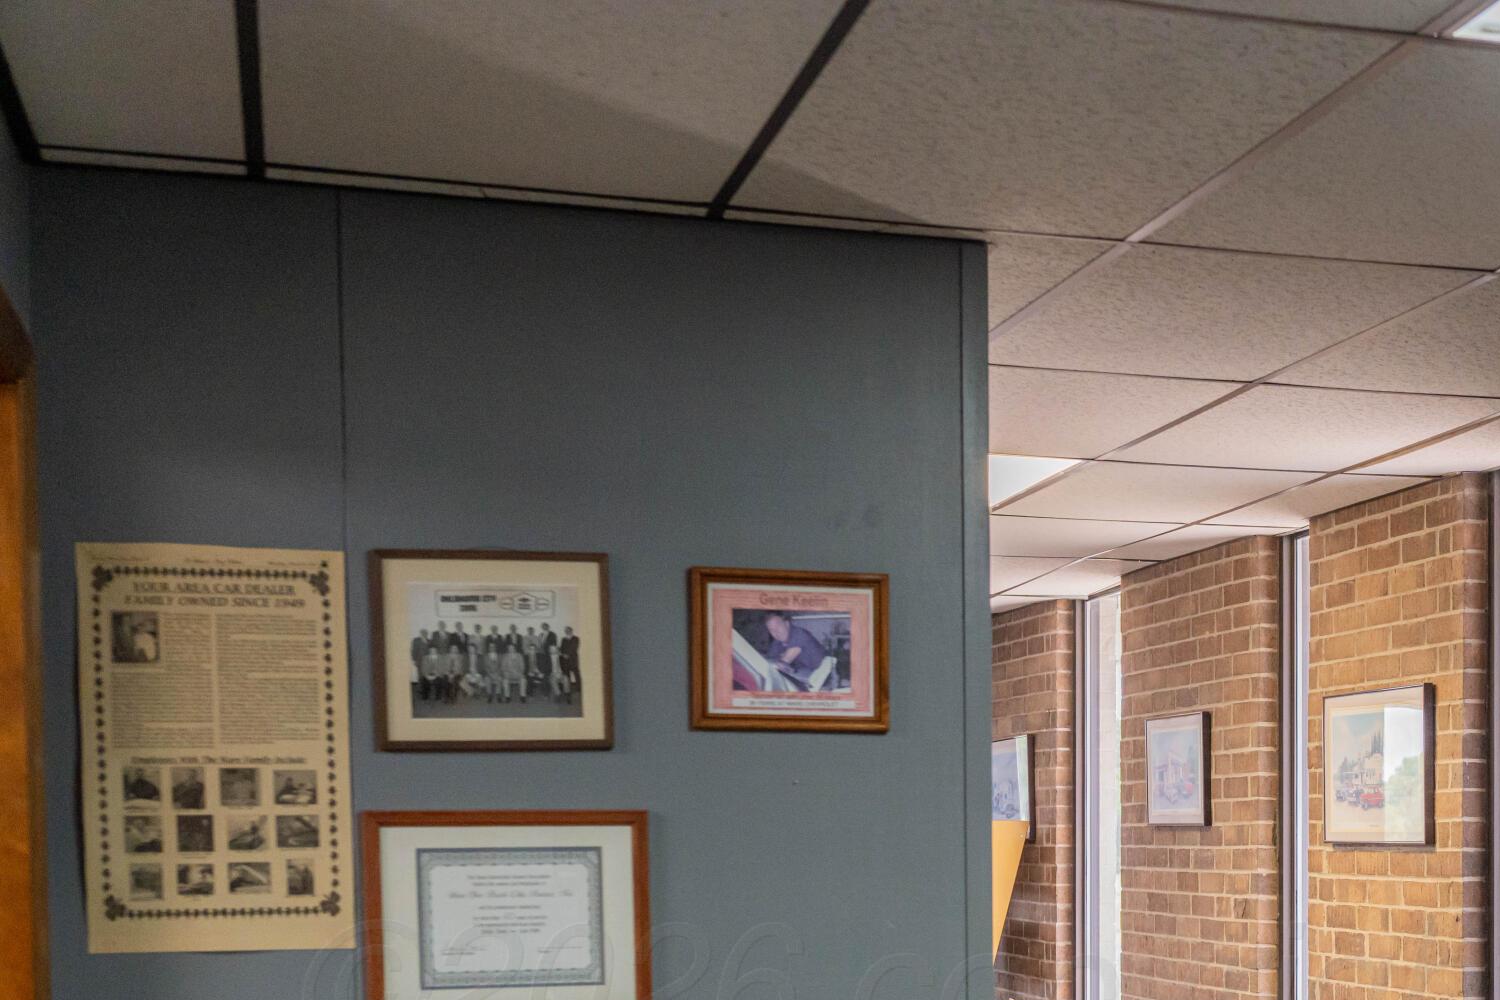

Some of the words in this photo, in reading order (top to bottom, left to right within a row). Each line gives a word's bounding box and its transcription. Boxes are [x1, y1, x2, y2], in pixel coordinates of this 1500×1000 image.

[176, 582, 210, 594] AREA
[213, 583, 241, 594] CAR
[245, 584, 296, 595] DEALER
[124, 595, 172, 605] FAMILY
[178, 596, 229, 607] OWNED
[231, 597, 270, 608] SINCE
[759, 592, 790, 607] Gene
